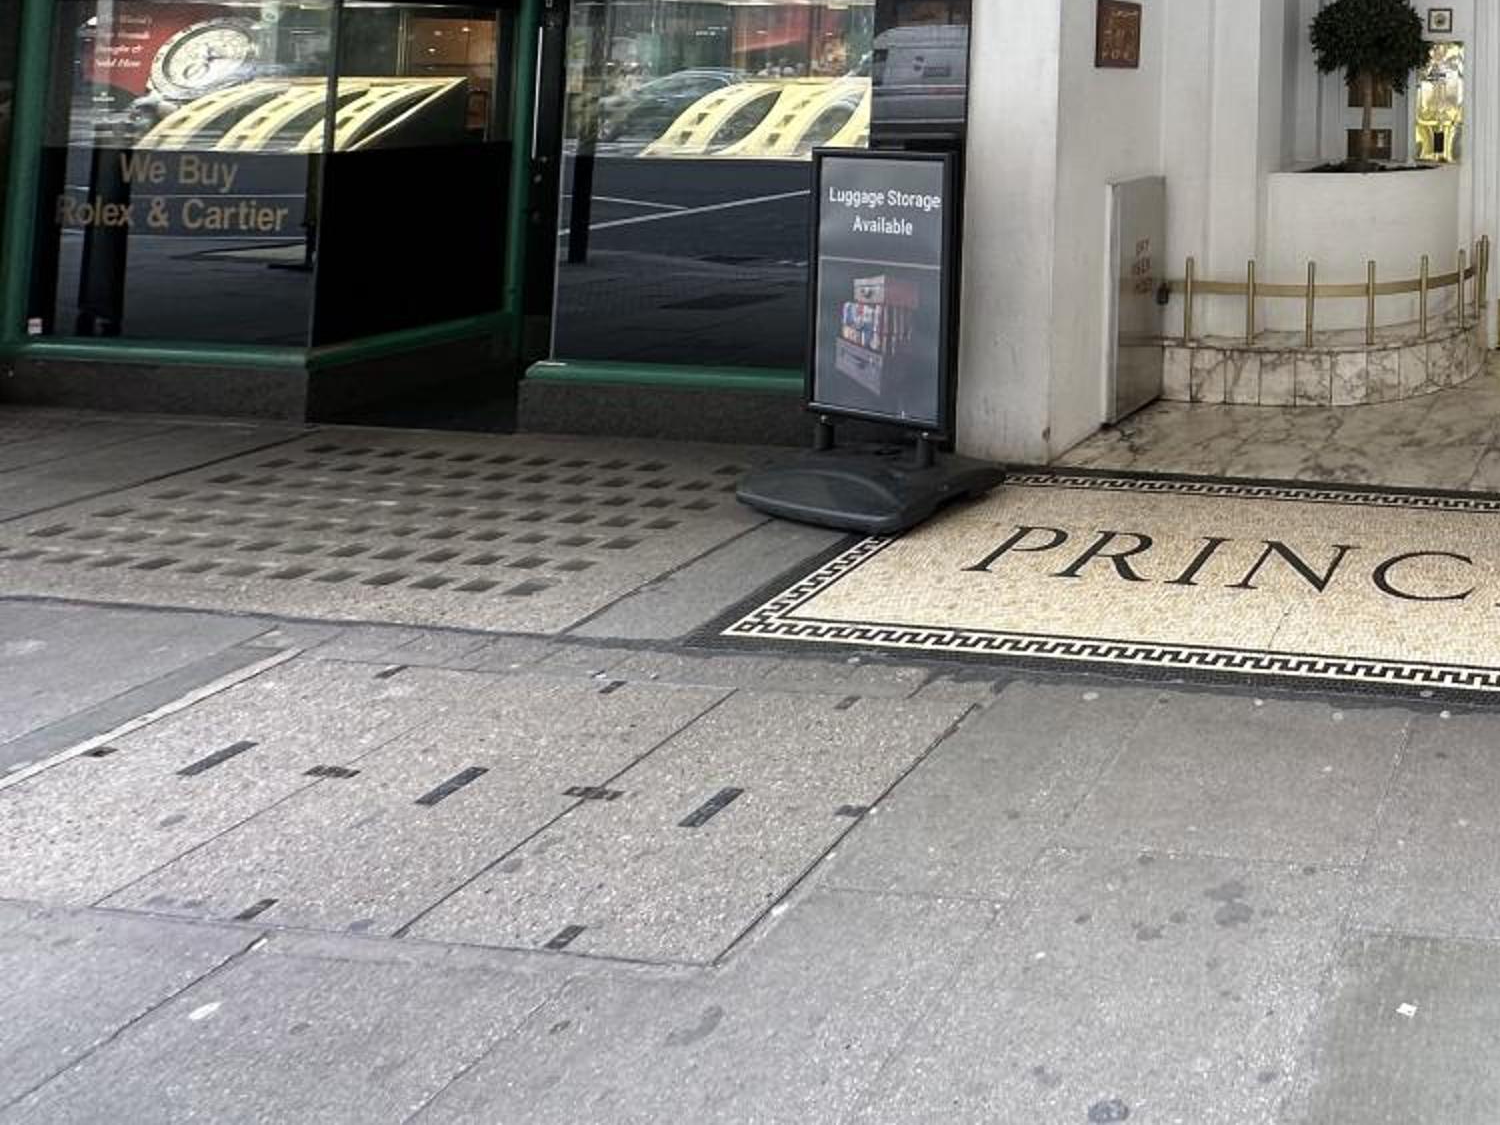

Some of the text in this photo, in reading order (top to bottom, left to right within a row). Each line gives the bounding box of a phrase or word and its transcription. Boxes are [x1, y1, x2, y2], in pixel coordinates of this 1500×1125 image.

[121, 153, 238, 193] We Buy
[57, 194, 289, 231] Rolex & Cartier
[829, 186, 942, 212] Luggage Storage
[853, 215, 913, 236] Available
